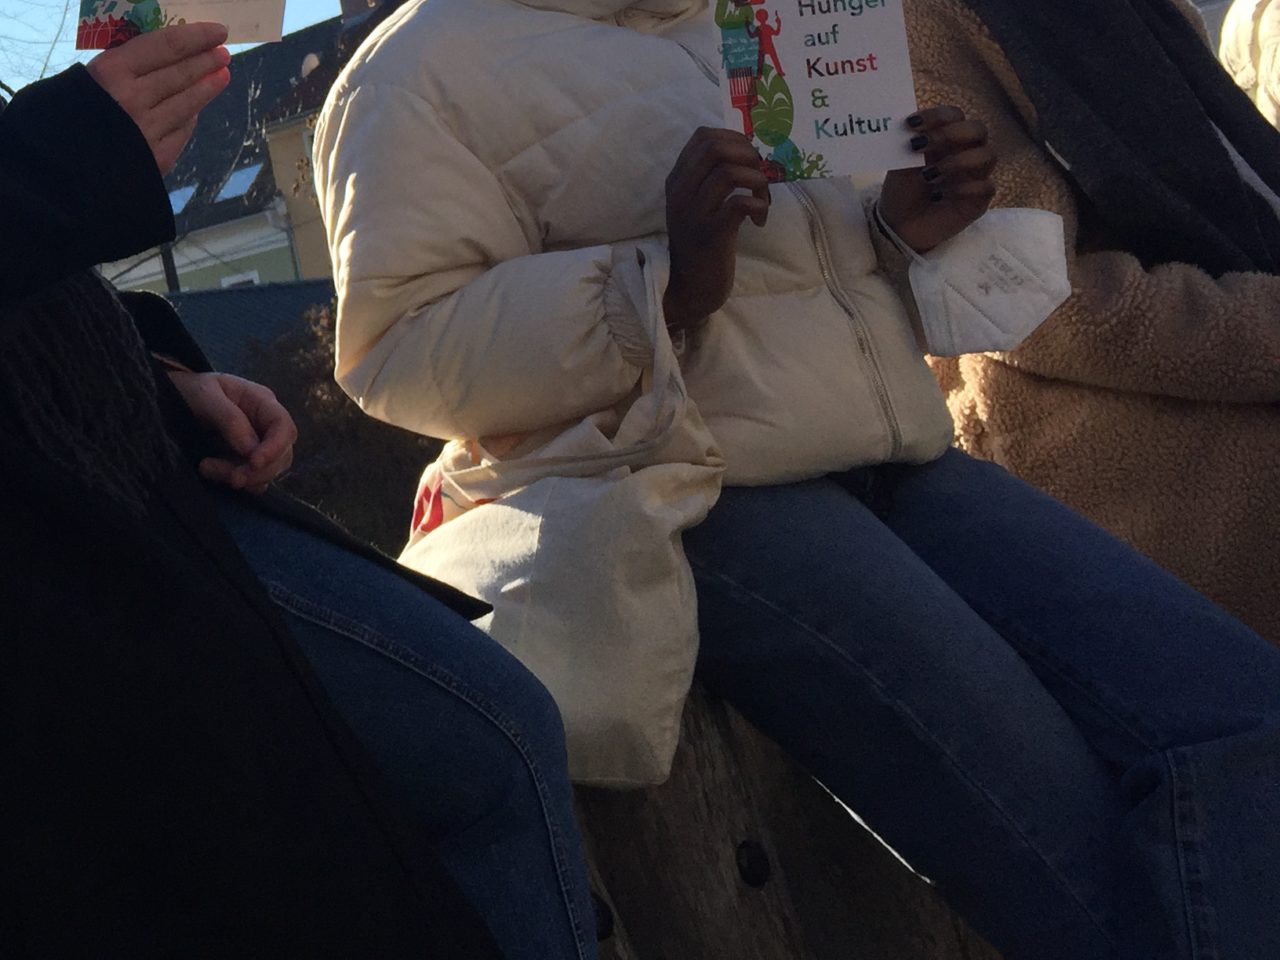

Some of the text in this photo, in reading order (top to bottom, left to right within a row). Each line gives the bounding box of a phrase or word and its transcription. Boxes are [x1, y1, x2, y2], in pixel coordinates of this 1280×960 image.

[804, 24, 839, 48] auf
[806, 53, 878, 79] Kunst
[811, 89, 829, 108] &
[814, 114, 892, 139] Kultur
